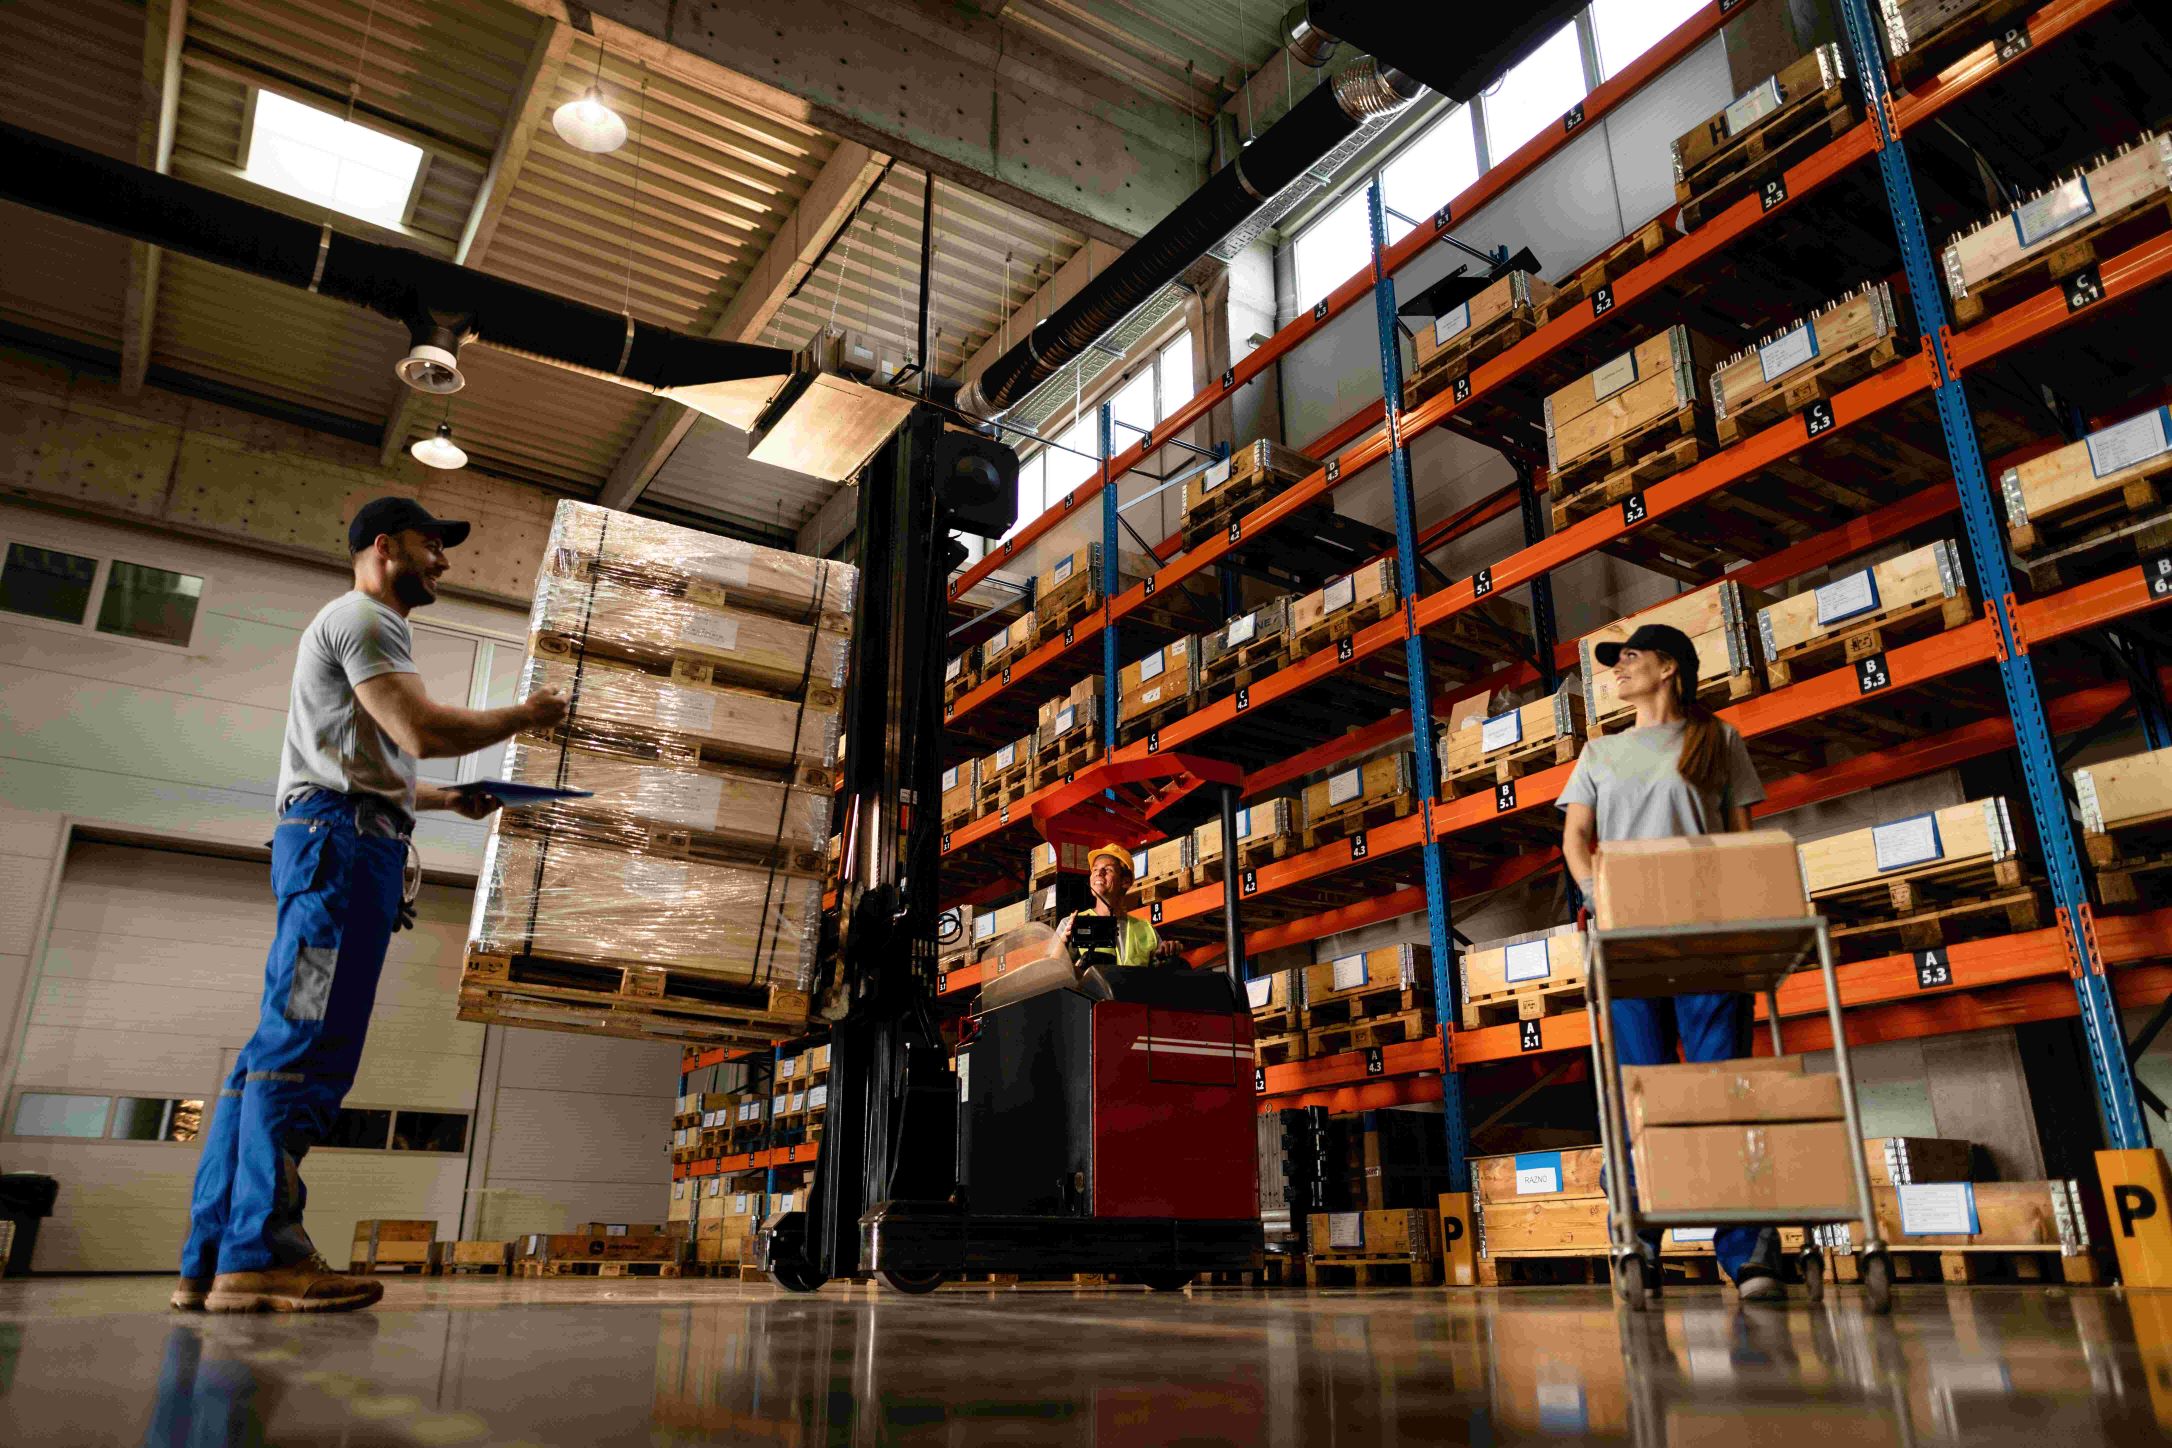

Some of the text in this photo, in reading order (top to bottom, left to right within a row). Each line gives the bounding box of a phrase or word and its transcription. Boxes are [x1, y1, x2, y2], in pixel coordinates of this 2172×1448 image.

[1723, 0, 1739, 10] 5.
[2005, 29, 2018, 43] D
[2002, 37, 2027, 58] 6.1
[1570, 107, 1576, 116] E
[1567, 113, 1583, 129] 5.2
[1709, 116, 1729, 147] H
[1766, 182, 1777, 194] D
[1765, 190, 1784, 208] 5.3
[1440, 208, 1445, 216] E
[1437, 214, 1449, 228] 5.1
[2076, 274, 2089, 288] C
[1598, 290, 1606, 301] D
[2072, 285, 2099, 306] 6.1
[1596, 298, 1612, 314] 5.2
[1458, 379, 1465, 389] D
[1456, 387, 1469, 401] 5.1
[1813, 405, 1823, 417] C
[1810, 415, 1831, 434] 5.3
[1329, 462, 1335, 470] D
[1327, 469, 1339, 480] 4.3
[1629, 497, 1637, 508] C
[1627, 507, 1644, 523] 5.2
[2157, 558, 2172, 575] B
[1479, 570, 1486, 581] C
[1476, 580, 1490, 595] 5.1
[1342, 639, 1348, 649] C
[1339, 648, 1352, 660] 4.3
[1865, 659, 1877, 673] B
[1863, 673, 1886, 690] 5.3
[1239, 690, 1245, 699] C
[1237, 698, 1248, 709] 4.2
[1151, 733, 1156, 742] C
[1149, 741, 1158, 752] 4.1
[1501, 784, 1509, 796] B
[1499, 796, 1514, 809] 5.1
[1355, 835, 1362, 845] B
[1353, 845, 1366, 856] 4.3
[1247, 872, 1253, 882] B
[1244, 882, 1256, 892] 4.2
[1152, 912, 1161, 922] 4.1
[1925, 951, 1938, 967] A
[1922, 967, 1947, 984] 5.3
[1526, 1022, 1535, 1034] A
[1524, 1035, 1539, 1048] 5.1
[1371, 1050, 1378, 1060] A
[1369, 1062, 1382, 1072] 4.3
[2112, 1184, 2158, 1238] P
[1444, 1216, 1463, 1252] P
